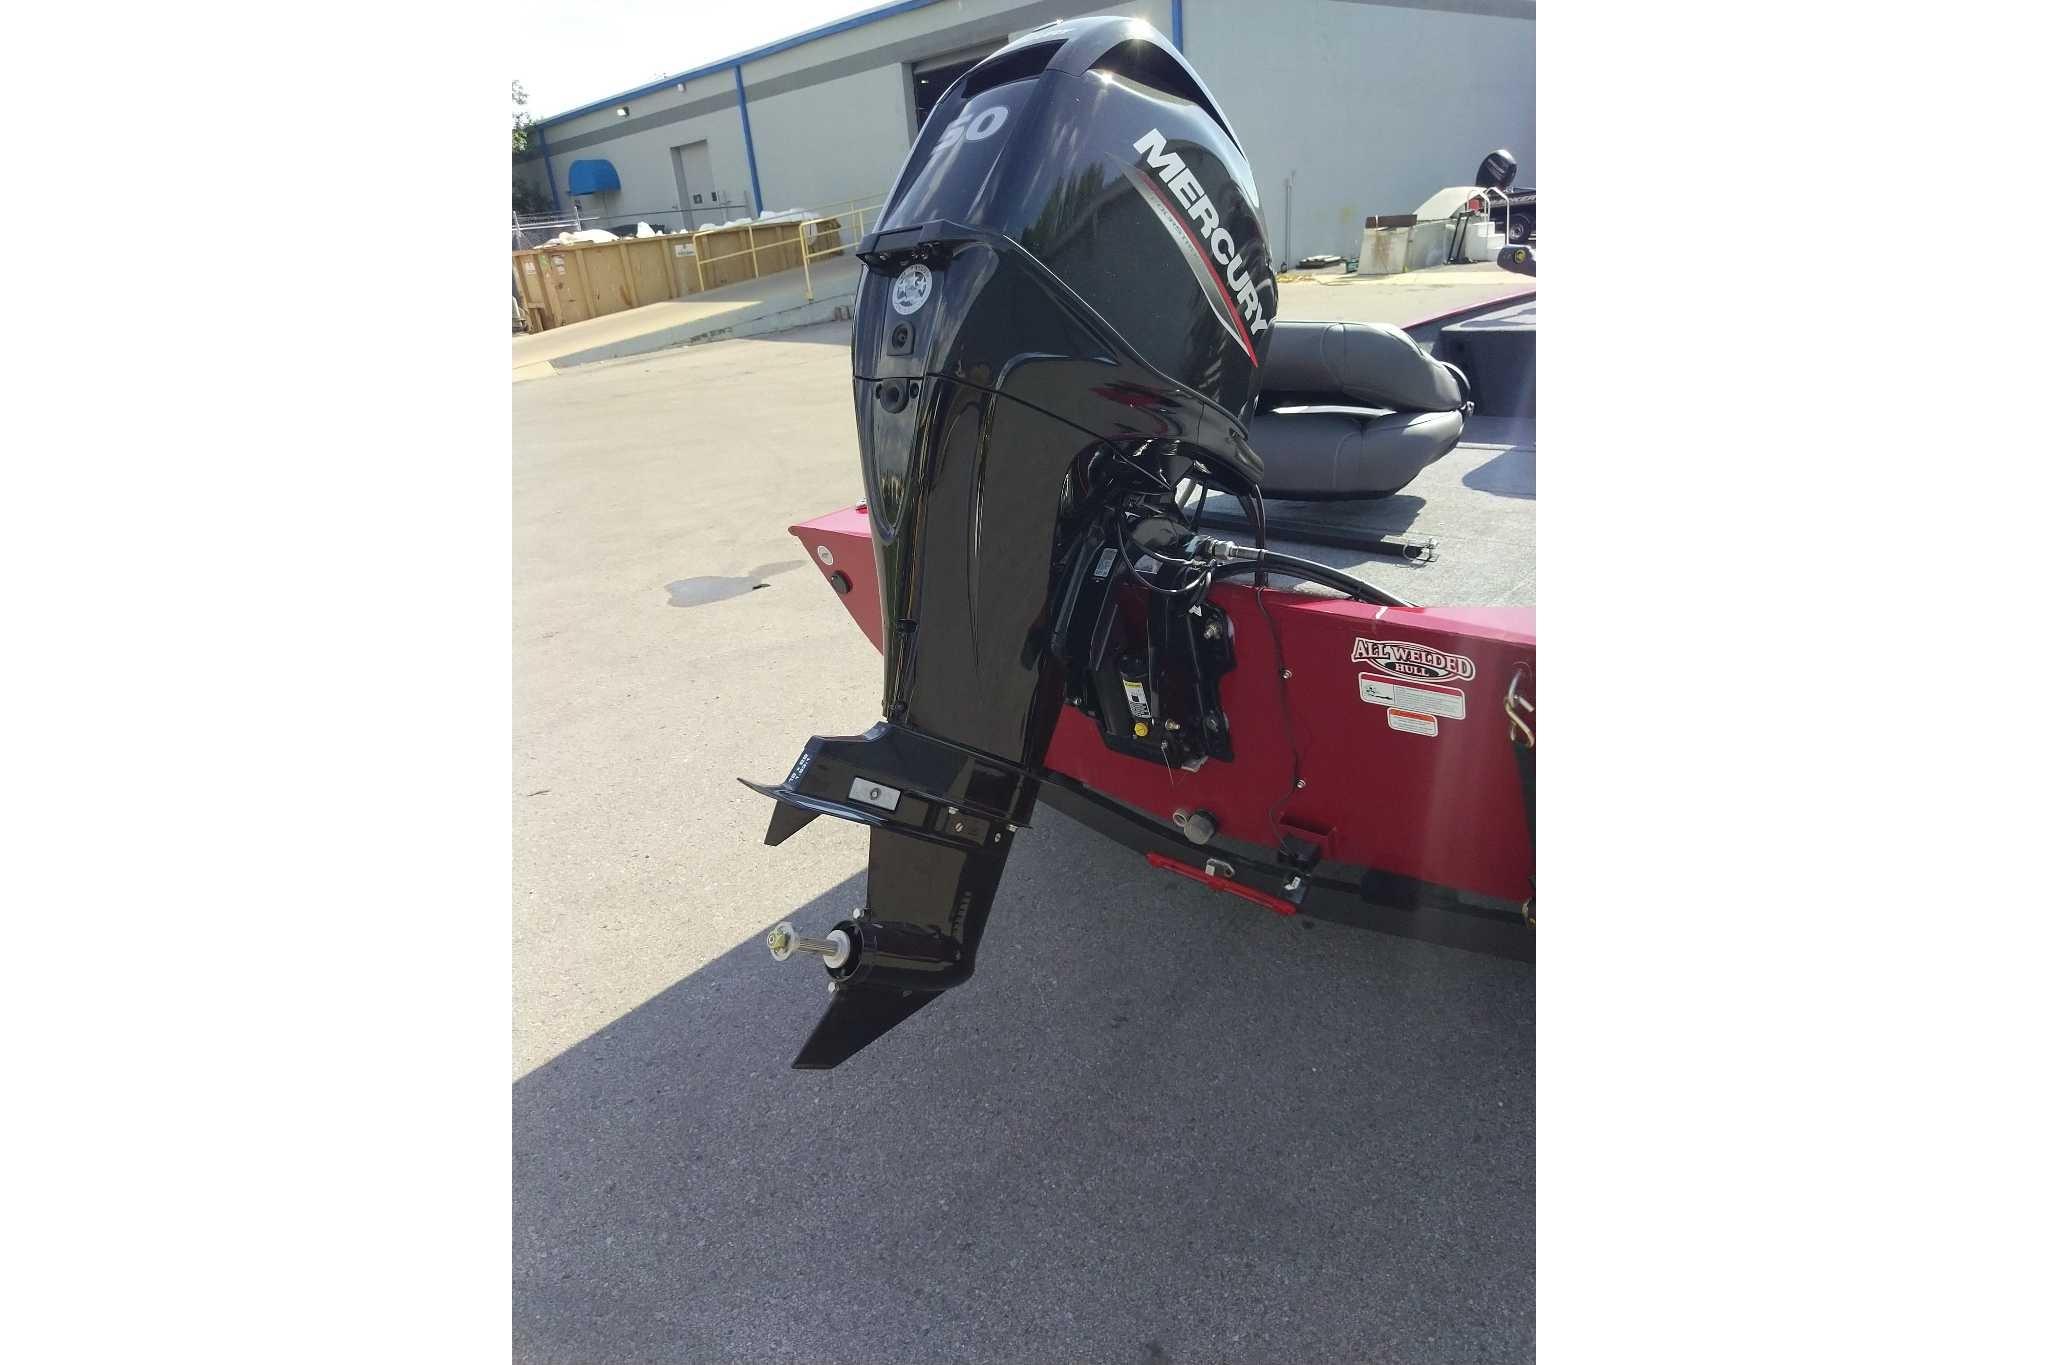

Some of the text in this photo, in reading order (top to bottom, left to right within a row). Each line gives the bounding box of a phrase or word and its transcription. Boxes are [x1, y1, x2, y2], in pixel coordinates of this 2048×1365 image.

[1133, 128, 1268, 335] MERCURY
[1355, 641, 1471, 677] ALL WELDED
[1395, 664, 1429, 676] HULL
